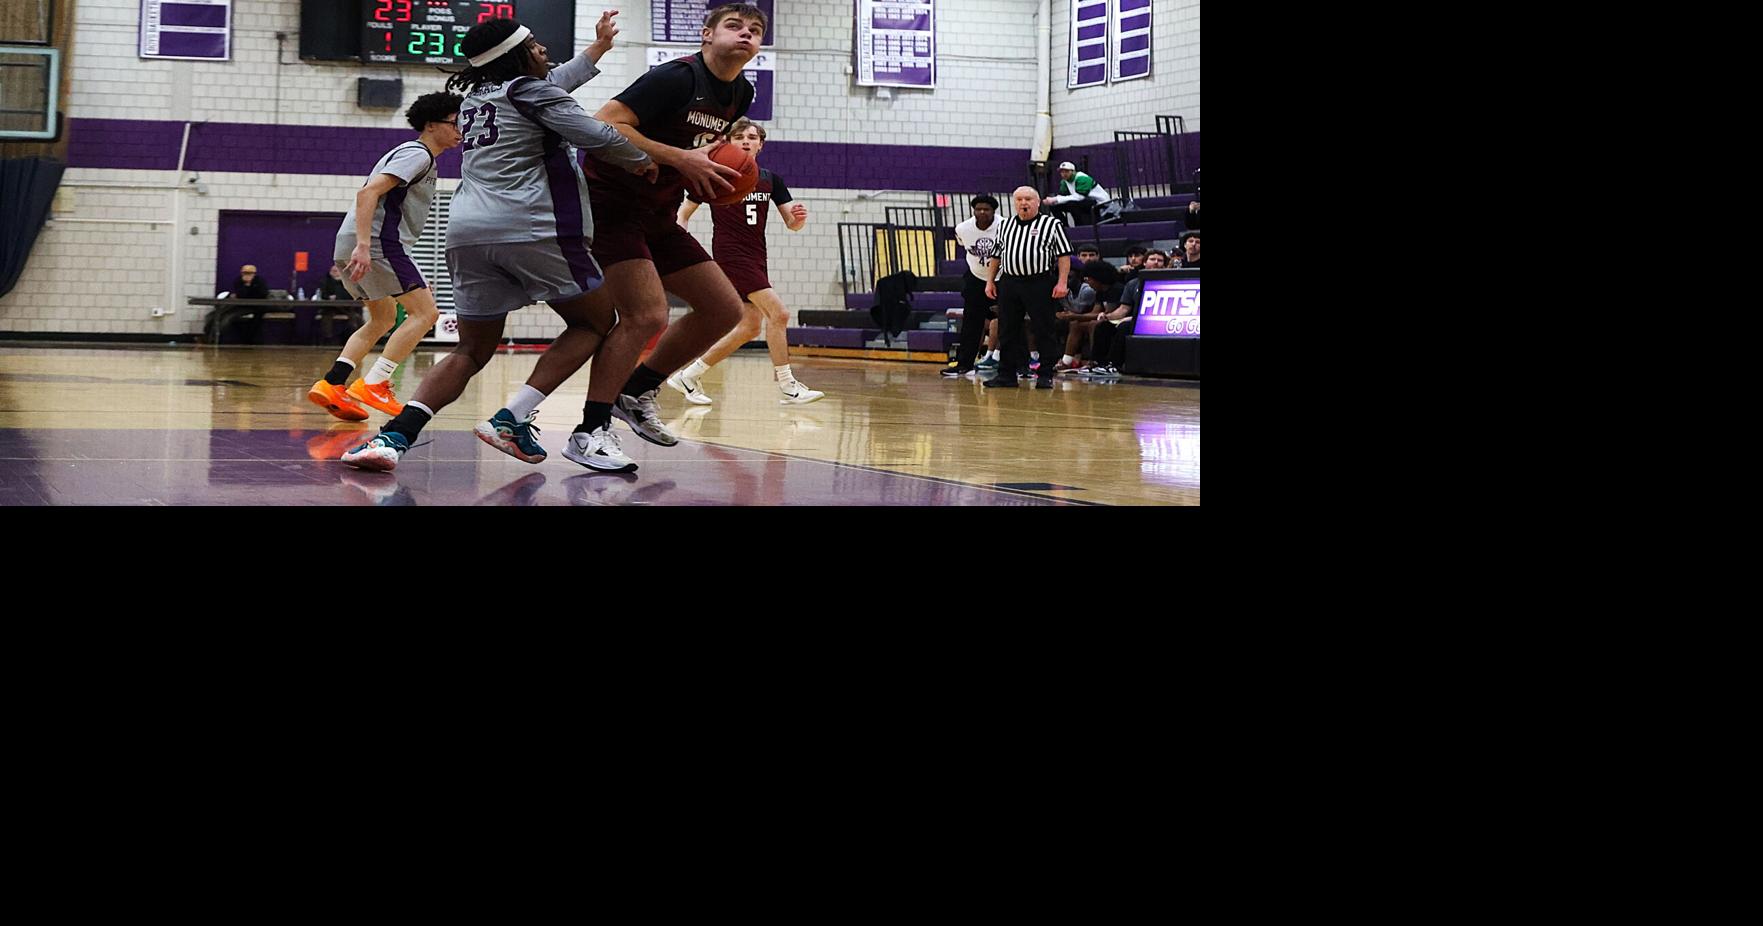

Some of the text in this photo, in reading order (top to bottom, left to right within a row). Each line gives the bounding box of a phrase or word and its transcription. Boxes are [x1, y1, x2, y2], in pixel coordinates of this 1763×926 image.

[374, 0, 411, 21] 23
[367, 21, 394, 29] FOULS
[411, 23, 442, 31] PLAYER
[384, 31, 392, 53] 1
[408, 32, 445, 55] 23
[425, 56, 453, 64] MATCH
[756, 55, 767, 66] P
[462, 101, 500, 151] 23
[742, 192, 771, 202] UMENT
[745, 204, 757, 225] 5
